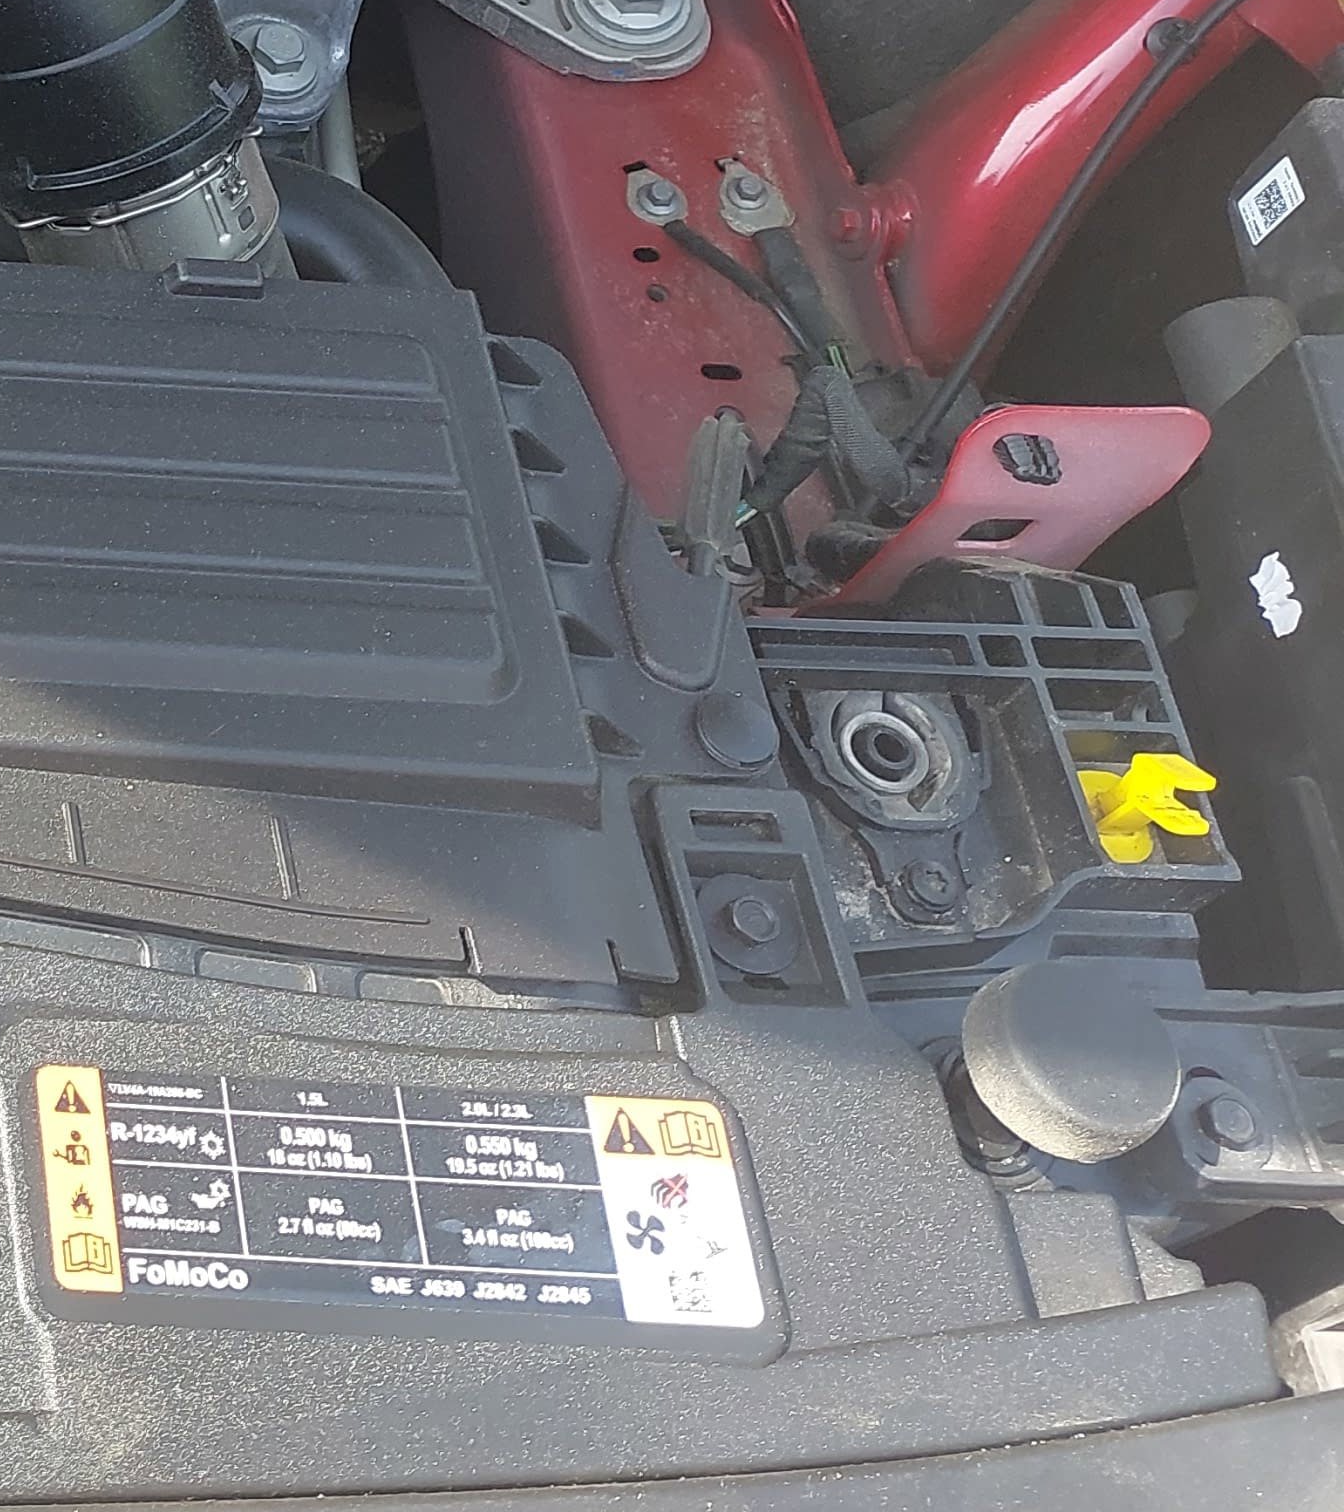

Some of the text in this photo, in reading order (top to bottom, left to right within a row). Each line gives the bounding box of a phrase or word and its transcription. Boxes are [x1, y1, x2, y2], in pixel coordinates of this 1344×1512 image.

[110, 1120, 197, 1150] R-1234yf
[280, 1125, 352, 1152] 0.500 kg
[465, 1134, 538, 1161] 0.550 kg
[121, 1193, 169, 1214] PAG
[308, 1196, 345, 1216] PAG
[278, 1216, 301, 1234] 2.7
[496, 1208, 533, 1227] PAG
[462, 1228, 486, 1245] 3.4
[128, 1257, 249, 1290] FoMoCo
[370, 1276, 414, 1295] SAE
